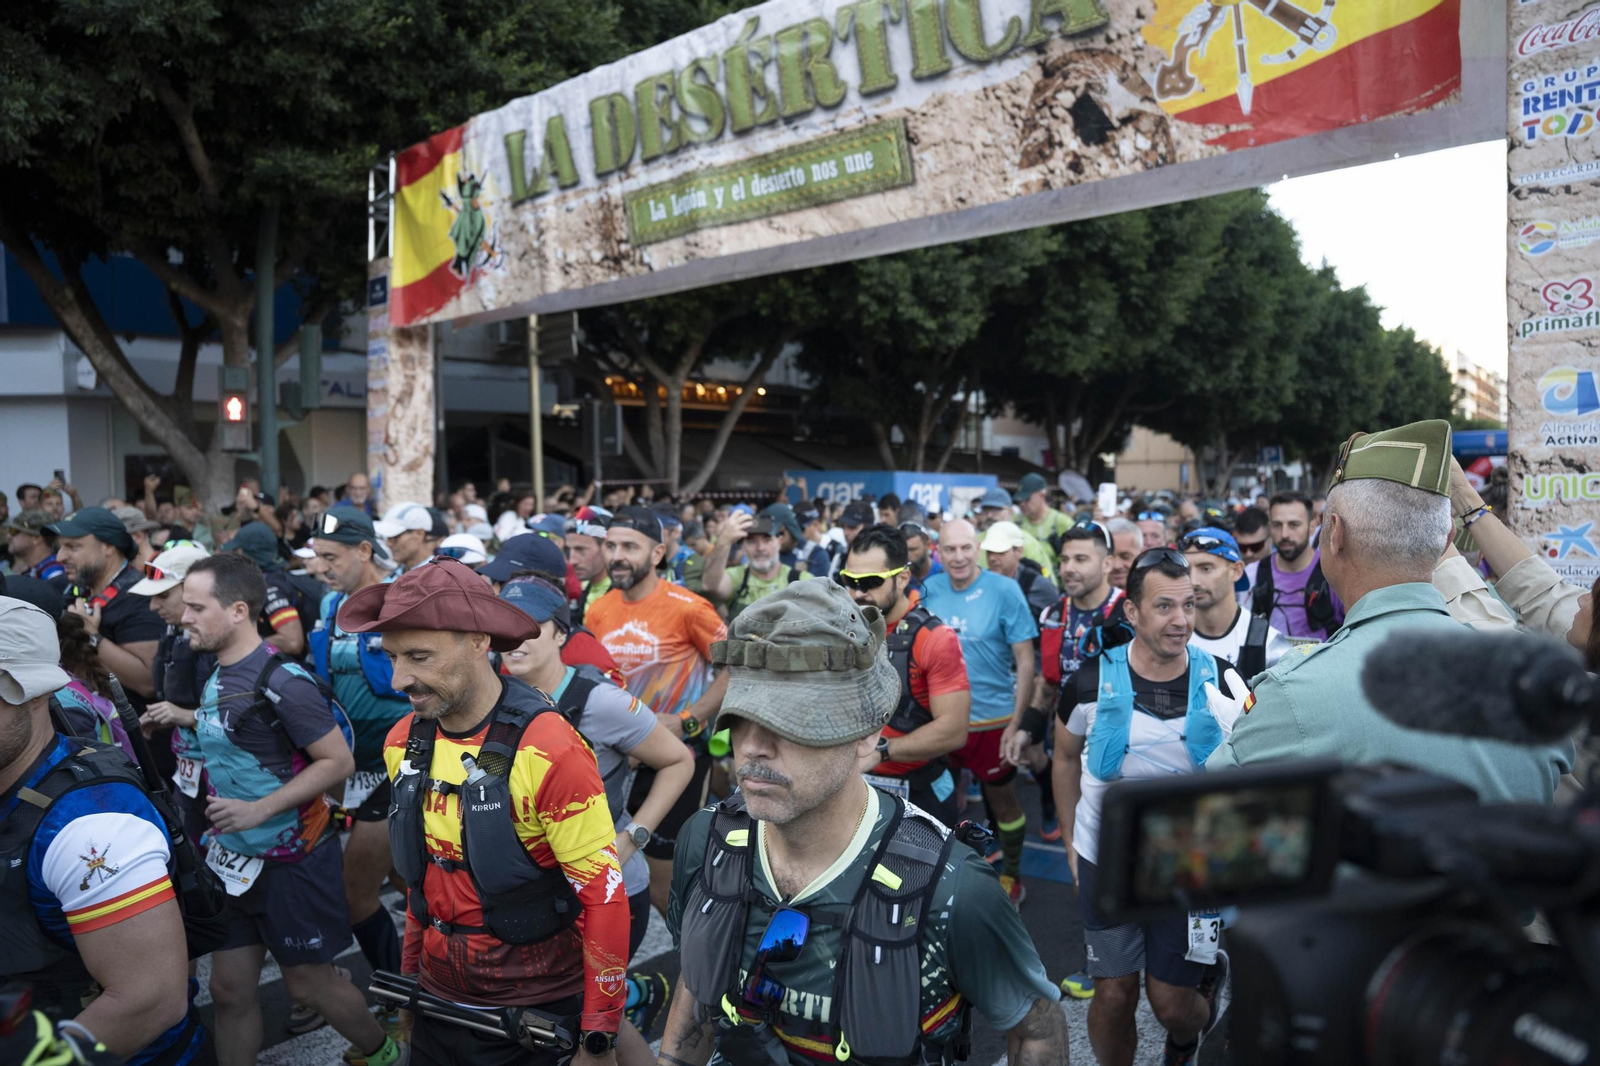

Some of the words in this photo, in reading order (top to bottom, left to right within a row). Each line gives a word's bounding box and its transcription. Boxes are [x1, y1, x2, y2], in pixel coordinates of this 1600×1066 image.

[1518, 8, 1600, 55] Coca-Co
[1523, 80, 1600, 115] RENT
[1522, 108, 1600, 140] TOD
[504, 114, 580, 206] LA
[649, 199, 667, 222] La
[713, 186, 725, 210] y
[731, 177, 746, 201] el
[751, 166, 806, 197] desierto
[811, 158, 839, 183] nos
[844, 150, 875, 174] une
[1545, 434, 1598, 446] Activa
[177, 758, 195, 778] 03
[472, 801, 501, 812] KIPRUN
[595, 975, 615, 983] ANSIA
